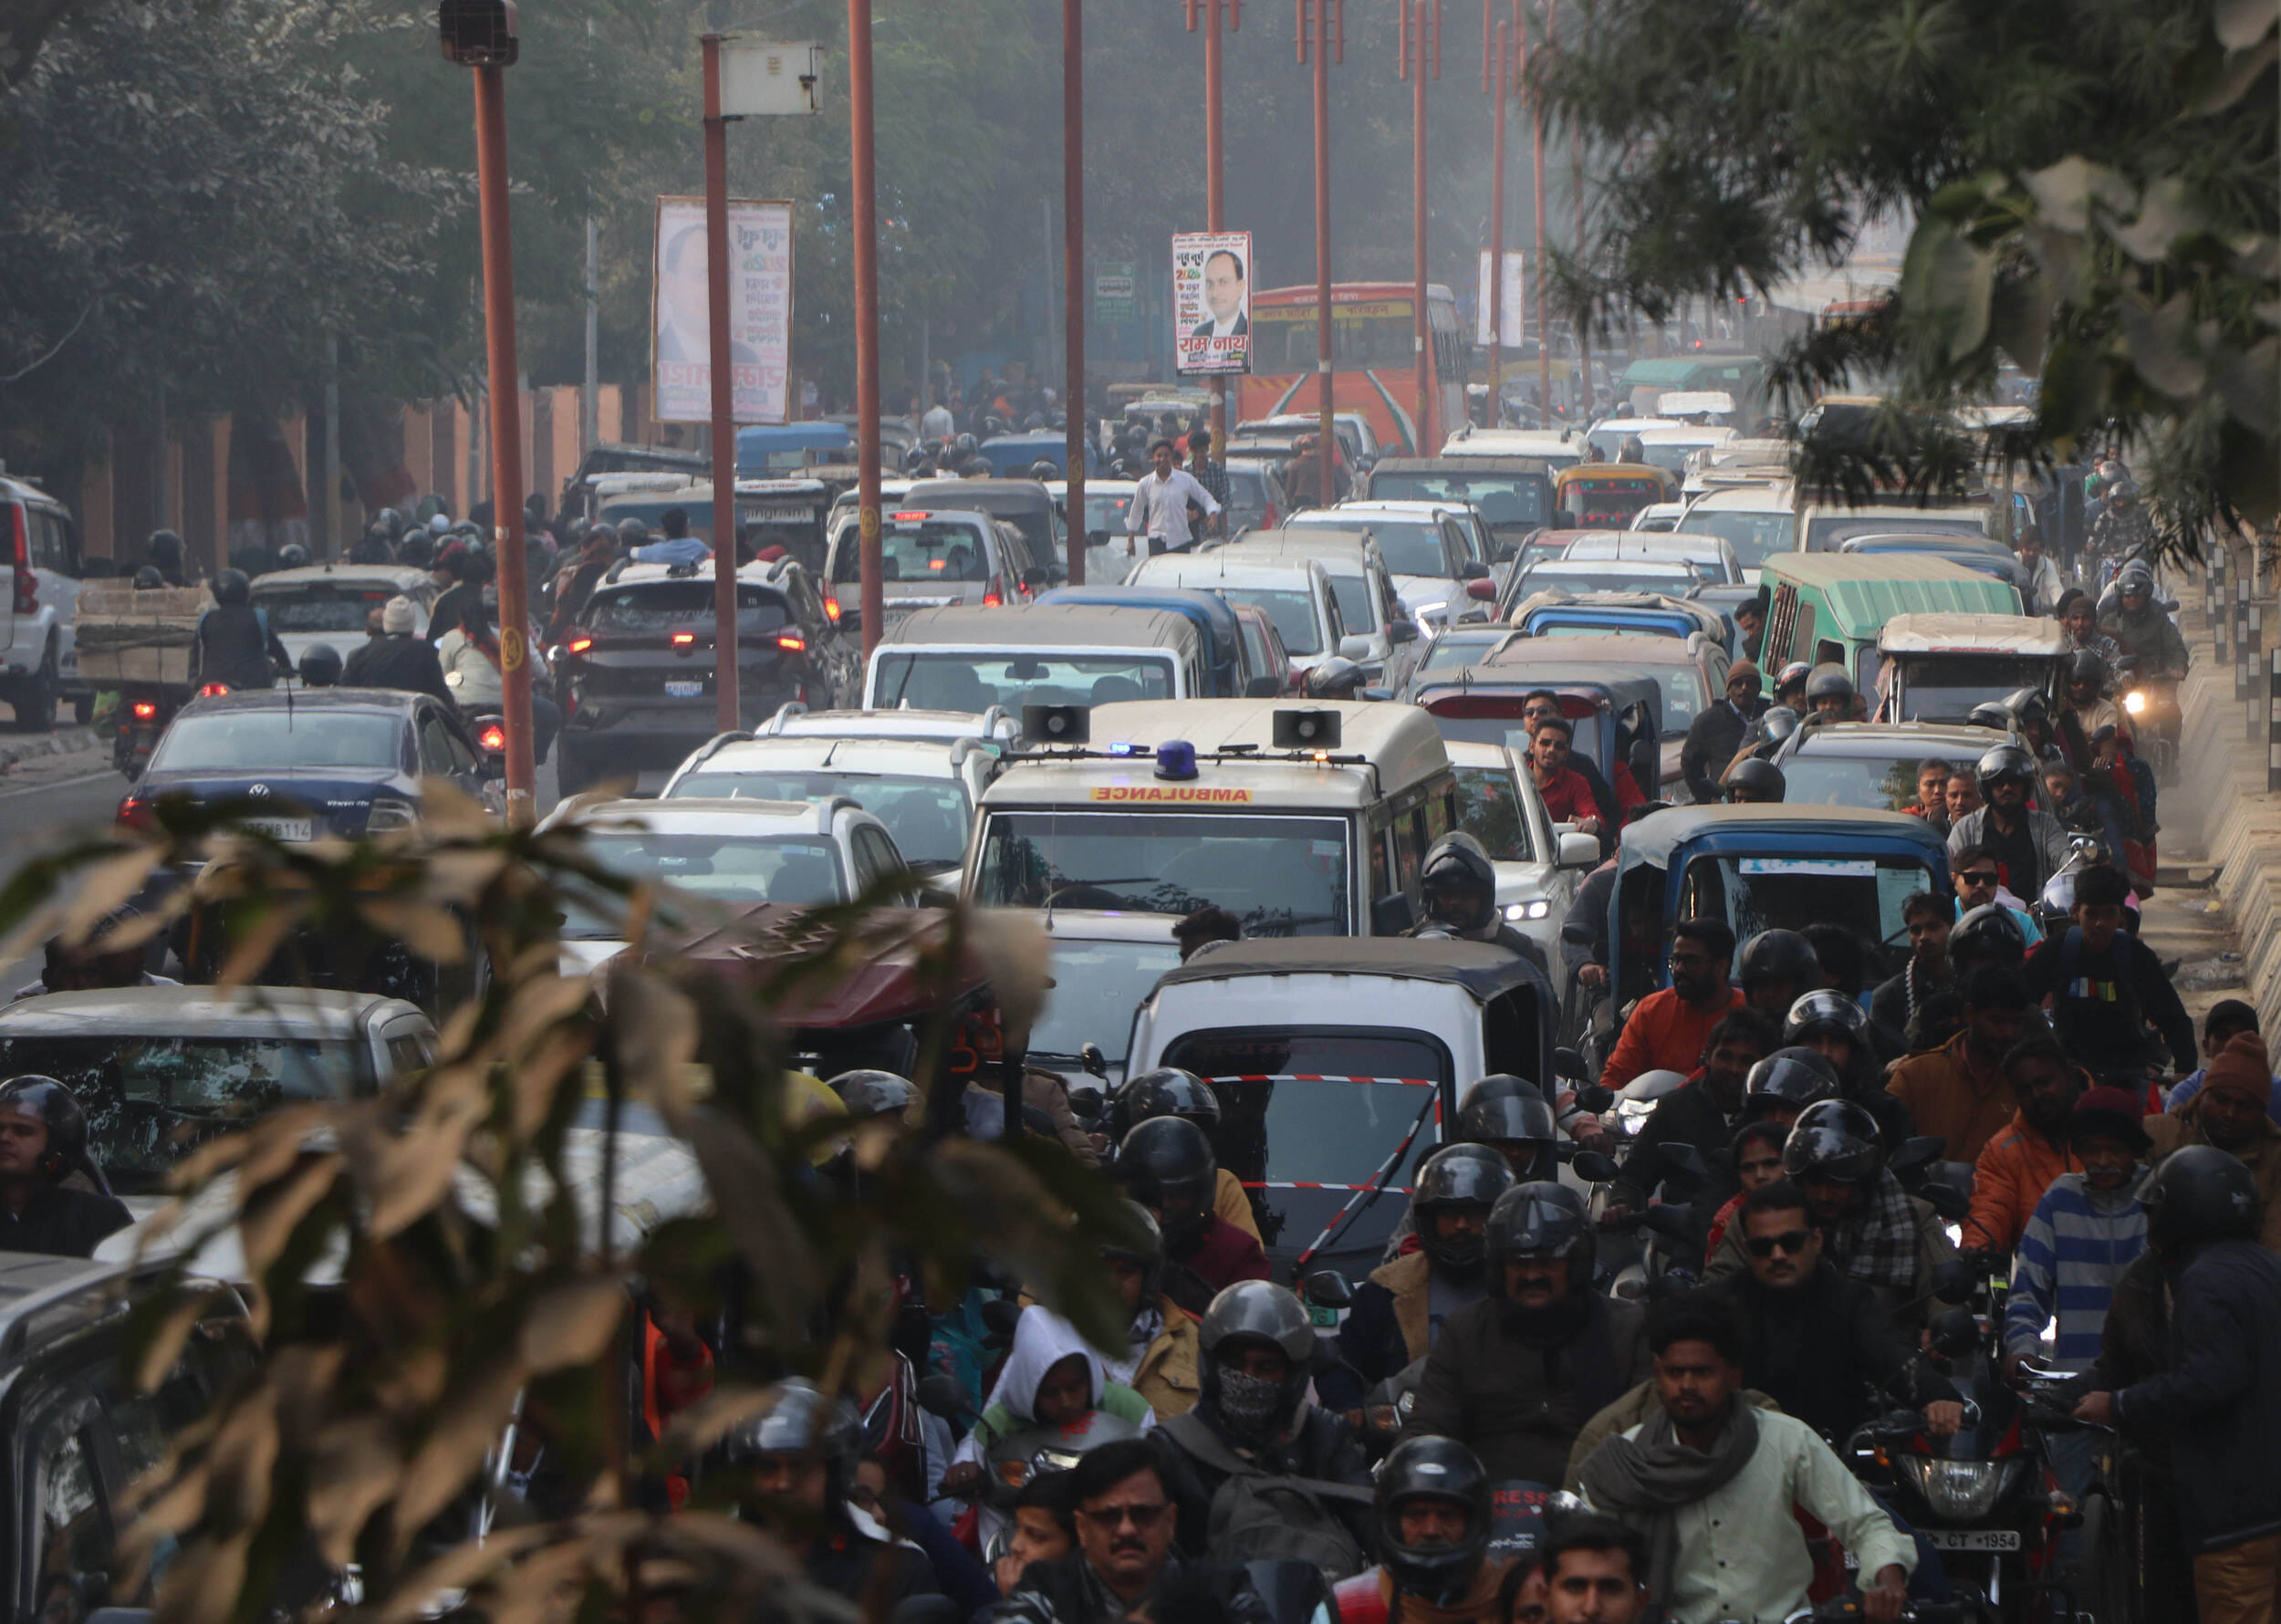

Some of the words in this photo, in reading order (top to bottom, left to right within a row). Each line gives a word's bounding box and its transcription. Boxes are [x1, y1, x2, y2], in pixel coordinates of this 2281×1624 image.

[1176, 268, 1201, 280] 2026
[1178, 337, 1208, 352] राम
[1213, 335, 1247, 351] नाथ
[1493, 1489, 1548, 1506] RESS
[1983, 1533, 2016, 1548] 1954
